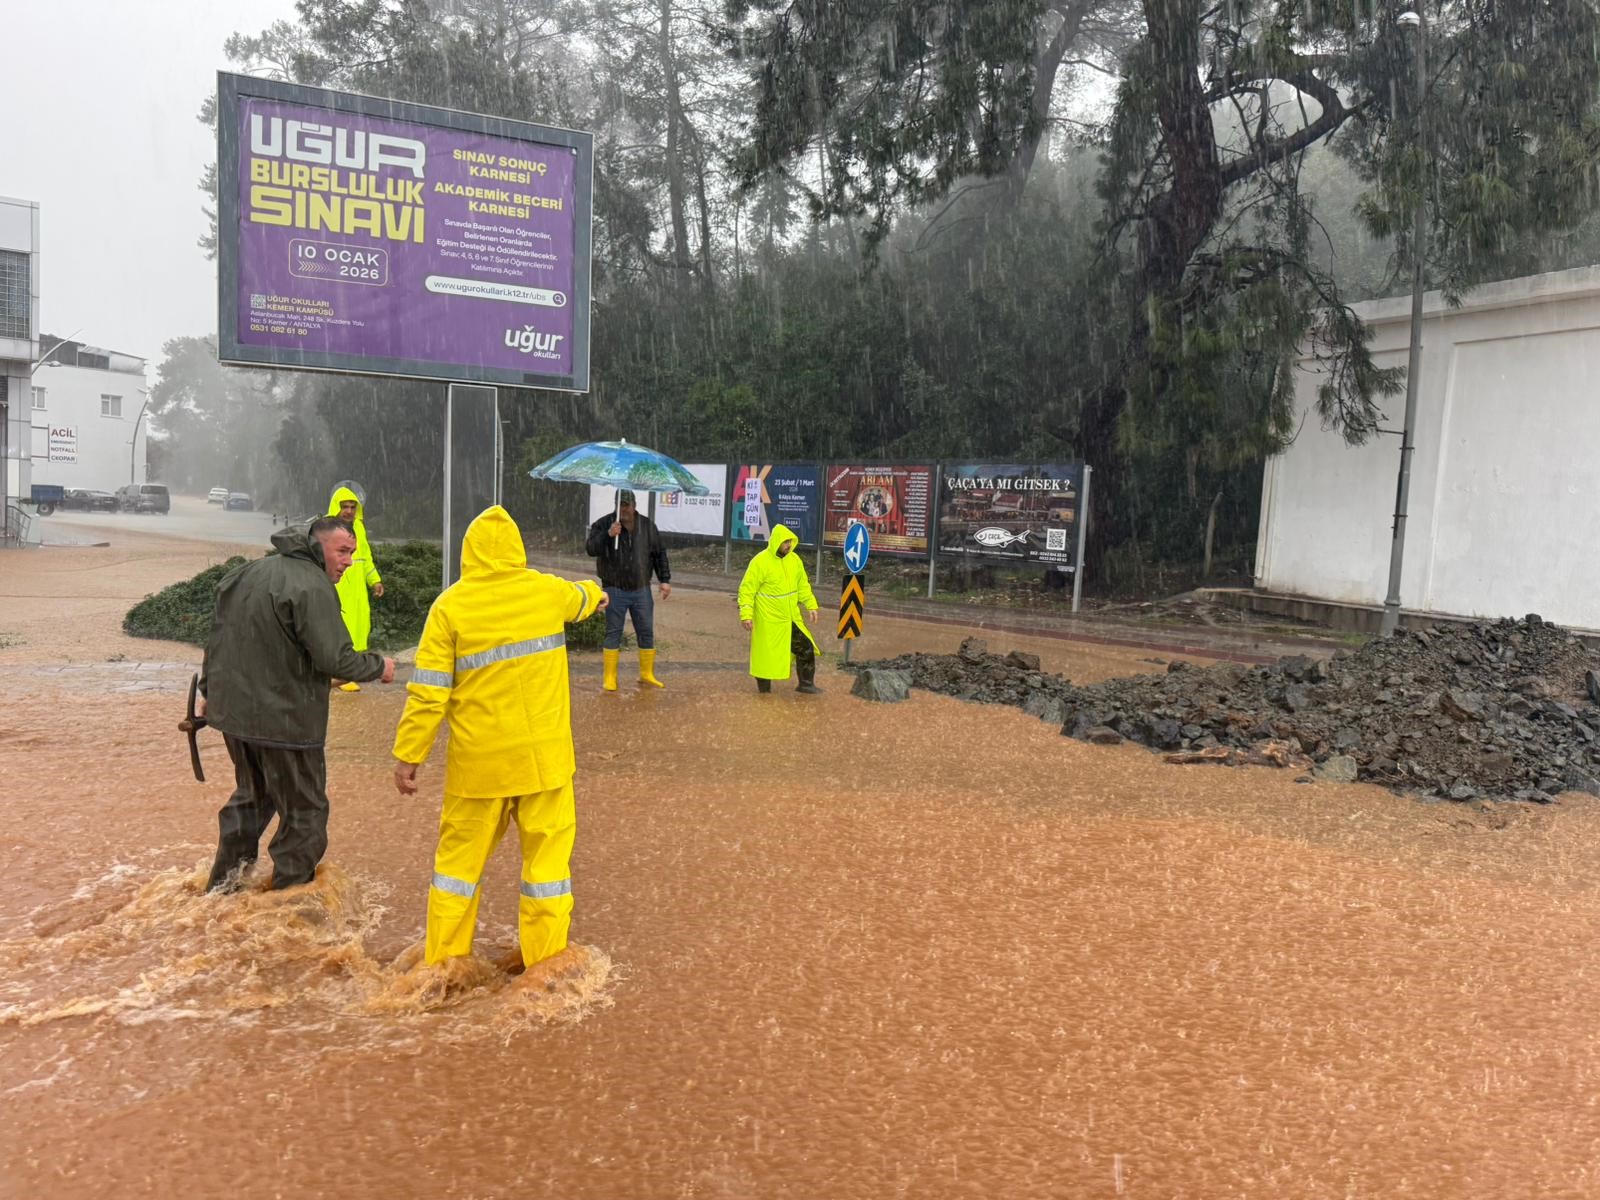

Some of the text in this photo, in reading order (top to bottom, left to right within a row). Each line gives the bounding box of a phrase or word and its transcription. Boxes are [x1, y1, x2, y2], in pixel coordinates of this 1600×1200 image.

[251, 114, 426, 179] UĞUR
[453, 149, 547, 176] SINAV SONUÇ
[251, 157, 425, 205] BURSLULUK
[469, 166, 531, 184] KARNESİ
[434, 182, 563, 210] AKADEMİK BECERİ
[250, 184, 425, 243] SINAVI
[468, 200, 530, 219] KARNESİ
[444, 219, 472, 229] Sınavda
[498, 226, 515, 235] Olan
[436, 238, 459, 248] Eğitim
[460, 241, 487, 252] Desteği
[487, 244, 495, 252] ile
[464, 231, 533, 247] Belirlenen Oranlarda
[298, 244, 380, 266] 10 OCAK
[340, 265, 380, 280] 2026
[434, 281, 546, 302] www.ugurokullari.k12.tr/ubs
[266, 294, 330, 308] UĞUR OKULLARI
[266, 303, 334, 317] KEMER KAMPÜSÜ
[293, 320, 321, 329] ANTALYA
[504, 324, 565, 353] uğur
[51, 427, 76, 438] ACİL
[781, 479, 796, 487] Şubat
[947, 476, 1070, 491] ÇAÇA'YA MI GİTSEK ?
[747, 493, 758, 501] TAP
[745, 503, 759, 513] GÜN
[745, 515, 759, 524] LERİ
